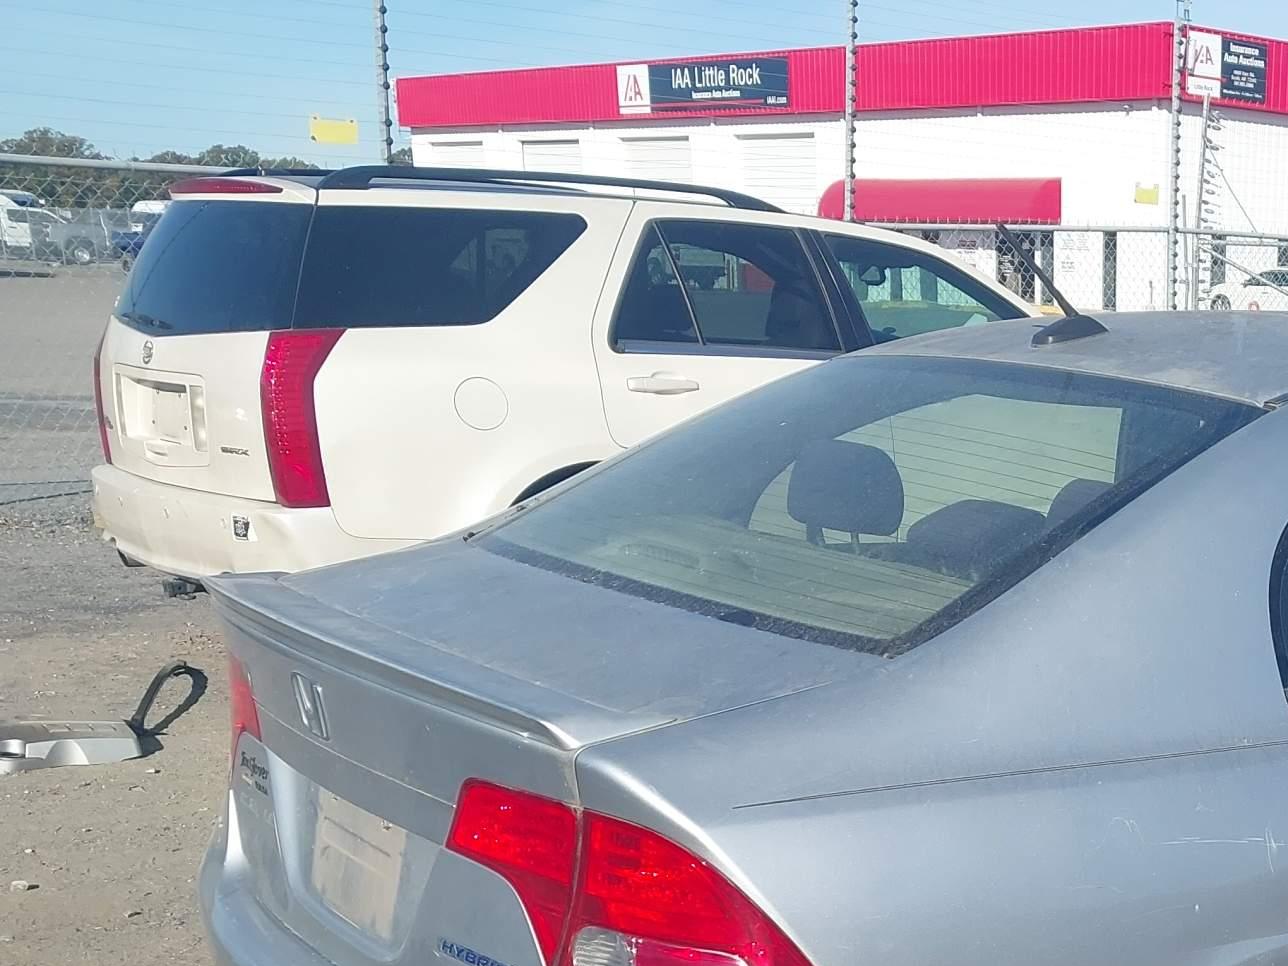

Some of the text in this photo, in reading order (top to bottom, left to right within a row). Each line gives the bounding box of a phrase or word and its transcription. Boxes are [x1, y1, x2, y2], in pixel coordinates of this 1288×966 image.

[672, 62, 761, 89] IAA Little Rock
